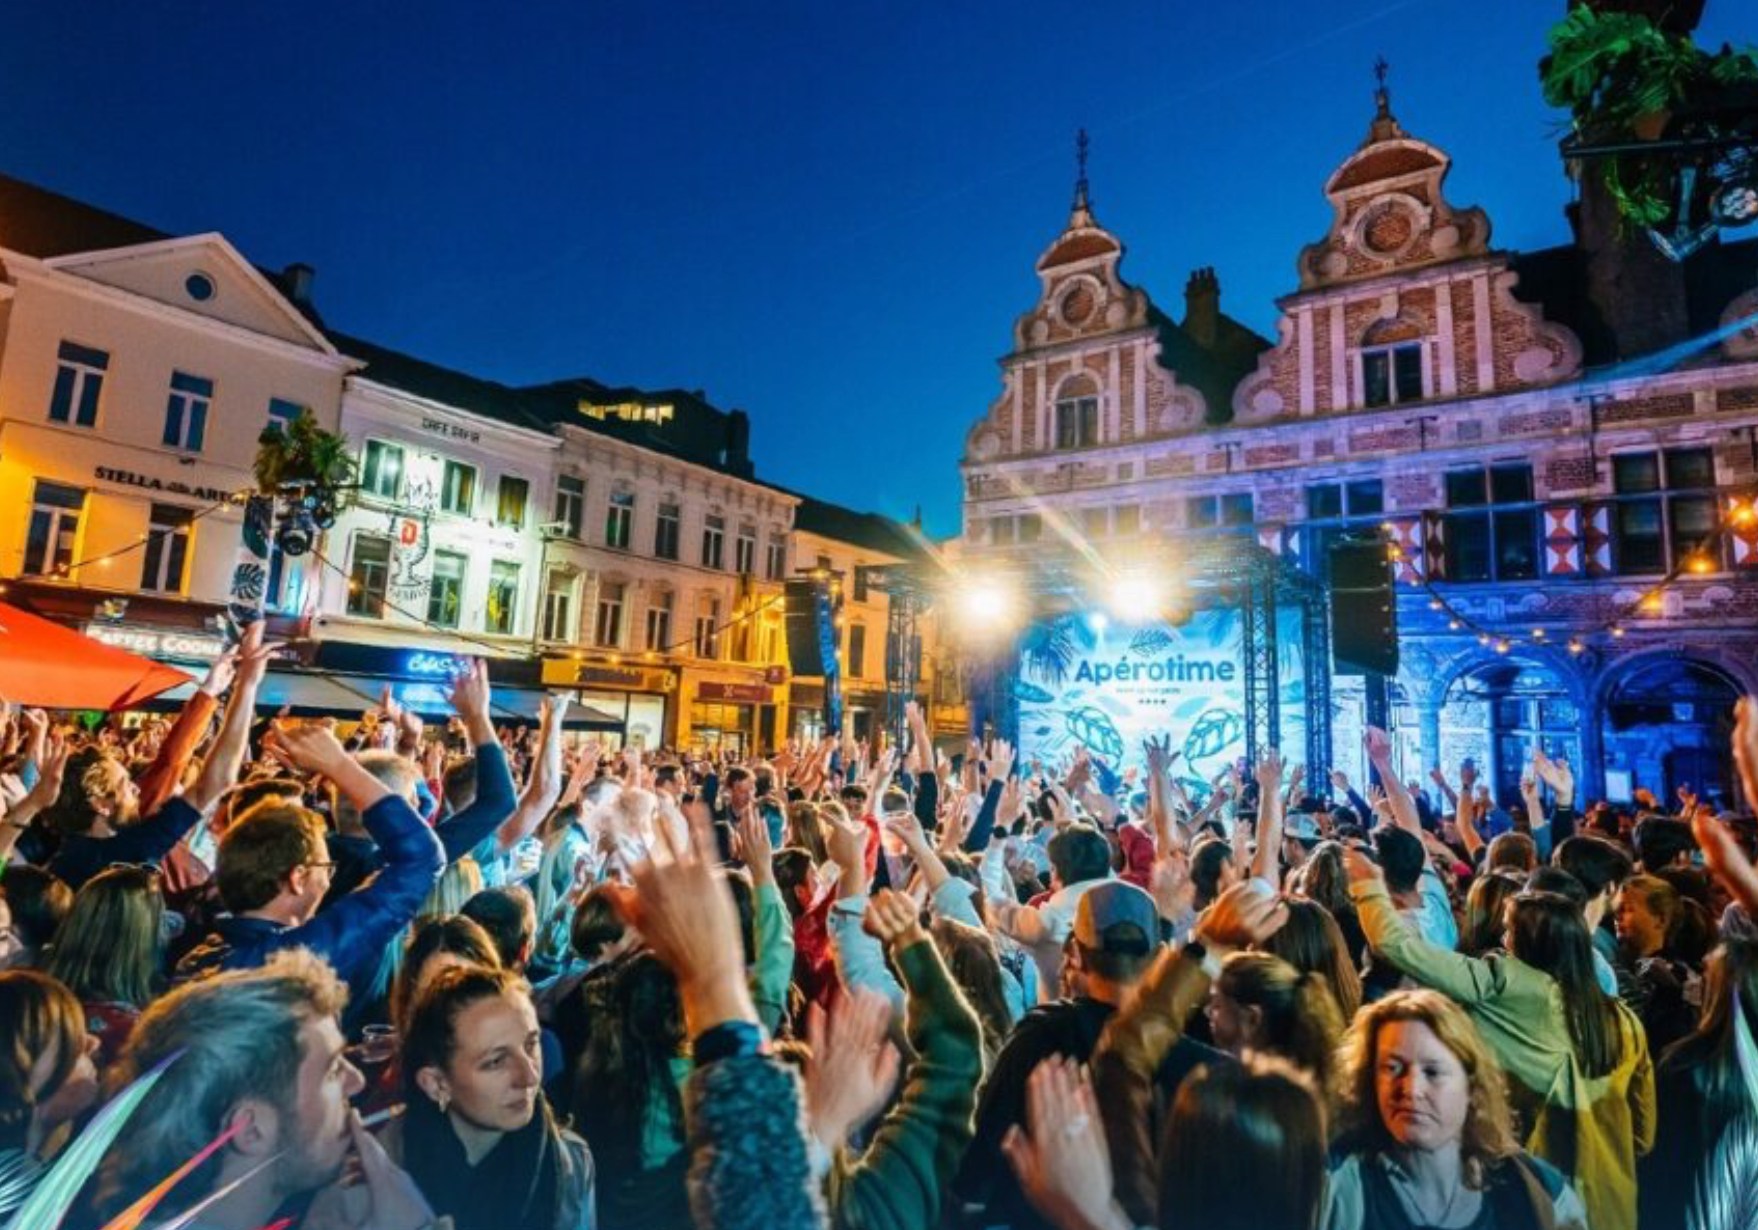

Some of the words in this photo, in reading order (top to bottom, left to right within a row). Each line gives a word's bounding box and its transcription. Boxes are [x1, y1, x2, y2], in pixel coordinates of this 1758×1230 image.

[94, 465, 162, 490] STELLA
[193, 486, 245, 505] ART
[1074, 653, 1235, 686] Apérotime
